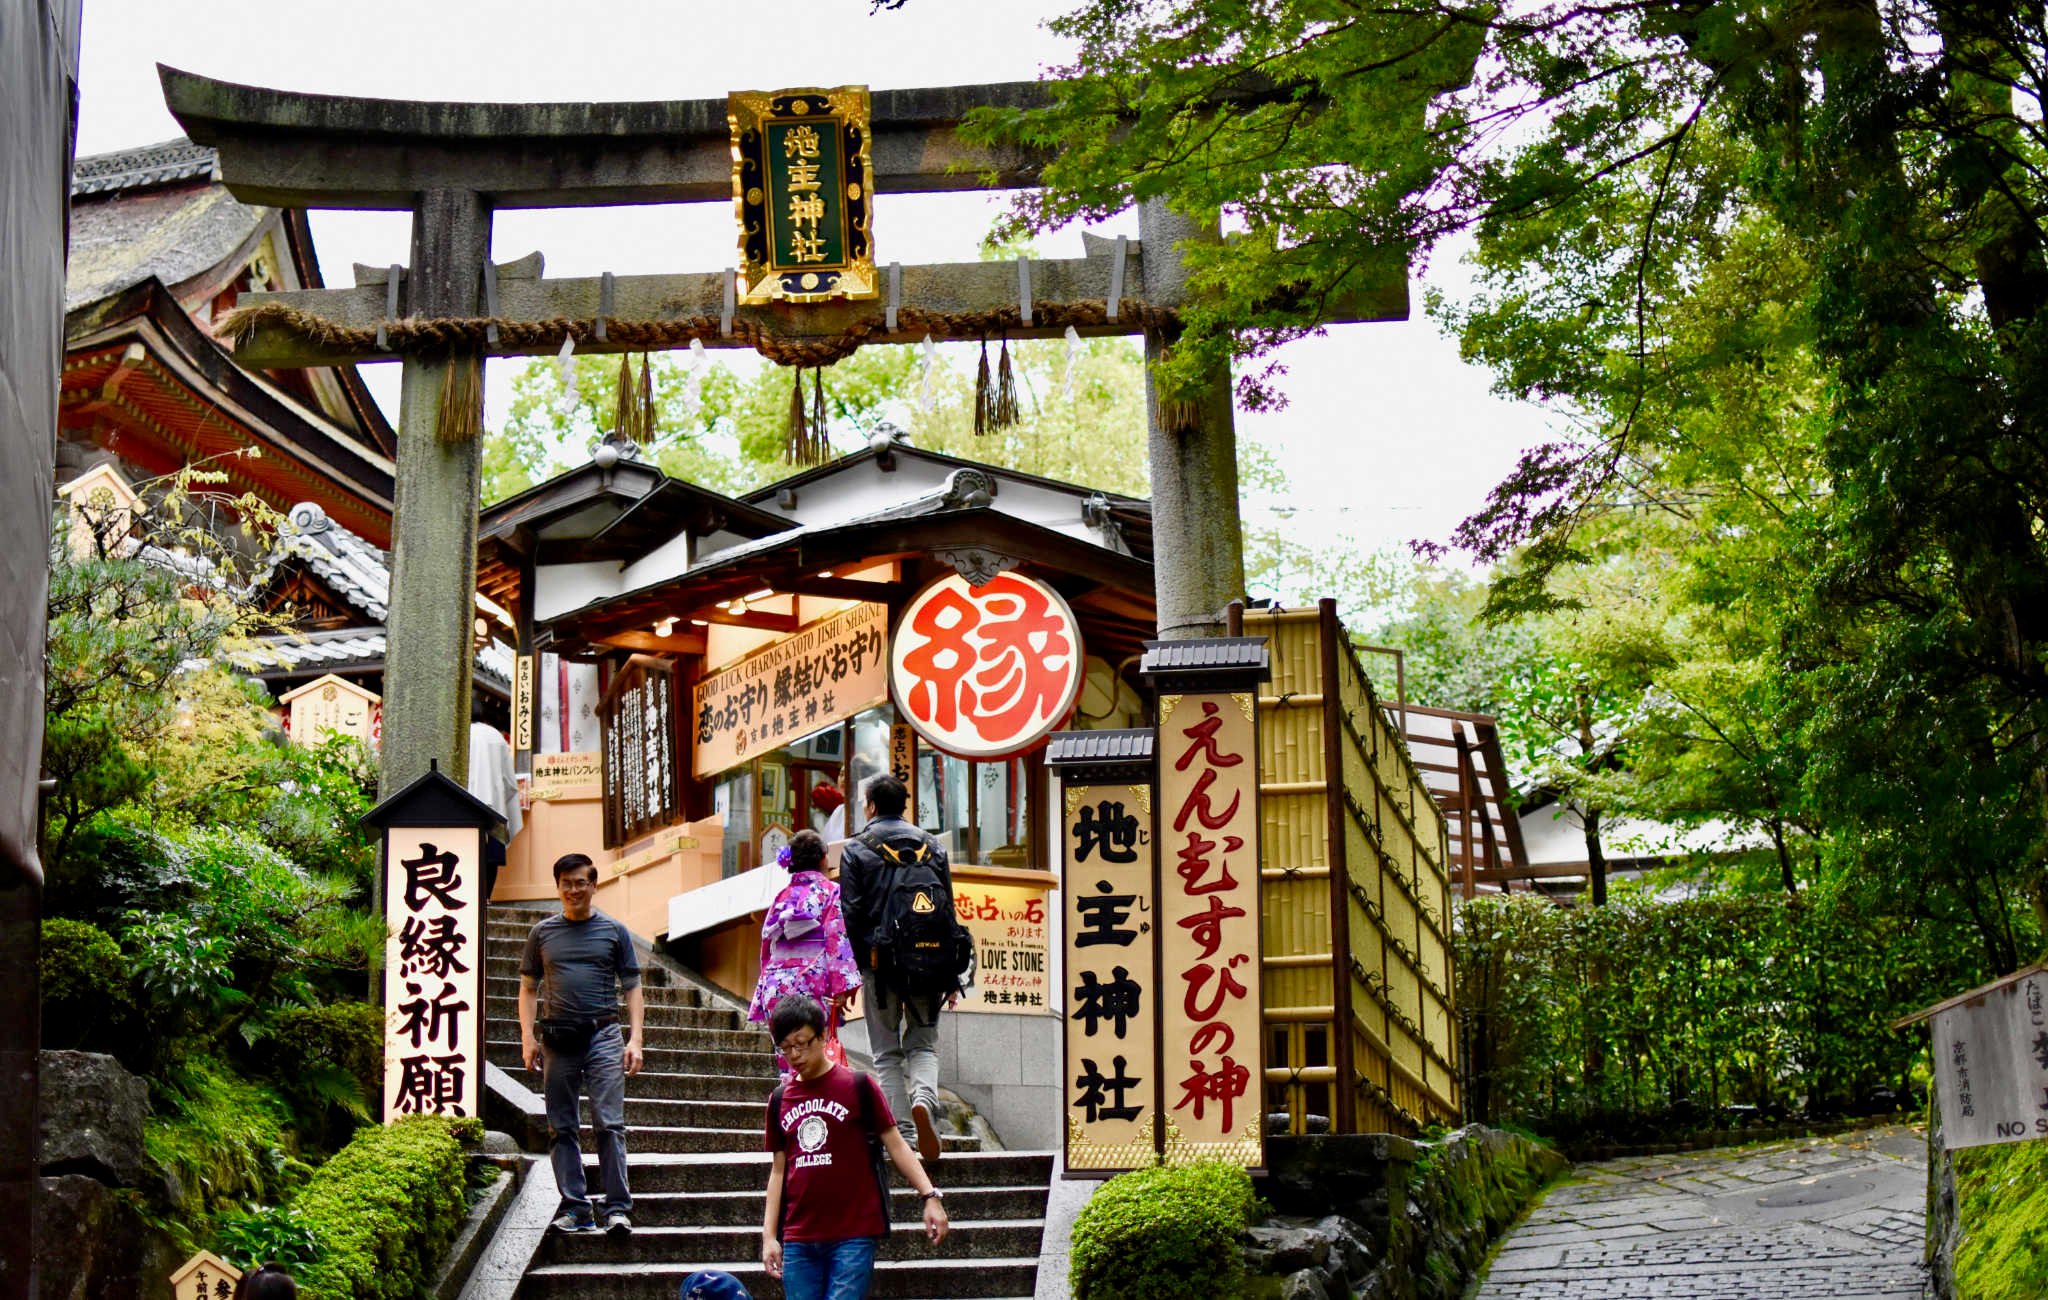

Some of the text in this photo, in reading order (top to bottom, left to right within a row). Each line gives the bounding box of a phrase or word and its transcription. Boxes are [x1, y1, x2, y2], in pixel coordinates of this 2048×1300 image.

[784, 125, 829, 263] 地主神社
[697, 602, 882, 704] GOOD LUCK CHARMS KYOTO JISHU SHRINE
[697, 679, 768, 745] 恋のお守り
[773, 624, 882, 709] 縁結びお守り
[519, 660, 529, 746] 恋占いおみくじ
[772, 690, 835, 737] 地主神社
[536, 766, 601, 778] 地主神社パンフレッ
[892, 727, 910, 783] 恋占いお
[954, 893, 1044, 924] 恋占いの石
[1174, 702, 1250, 1134] えんむすびの神
[394, 843, 470, 1117] 良縁祈願
[981, 949, 1044, 973] LOVE STONE
[984, 990, 1043, 1007] 地主神社
[1073, 800, 1143, 1123] 地主神社
[1952, 1040, 1975, 1118] 京都市消防局
[1996, 1121, 2026, 1138] NO
